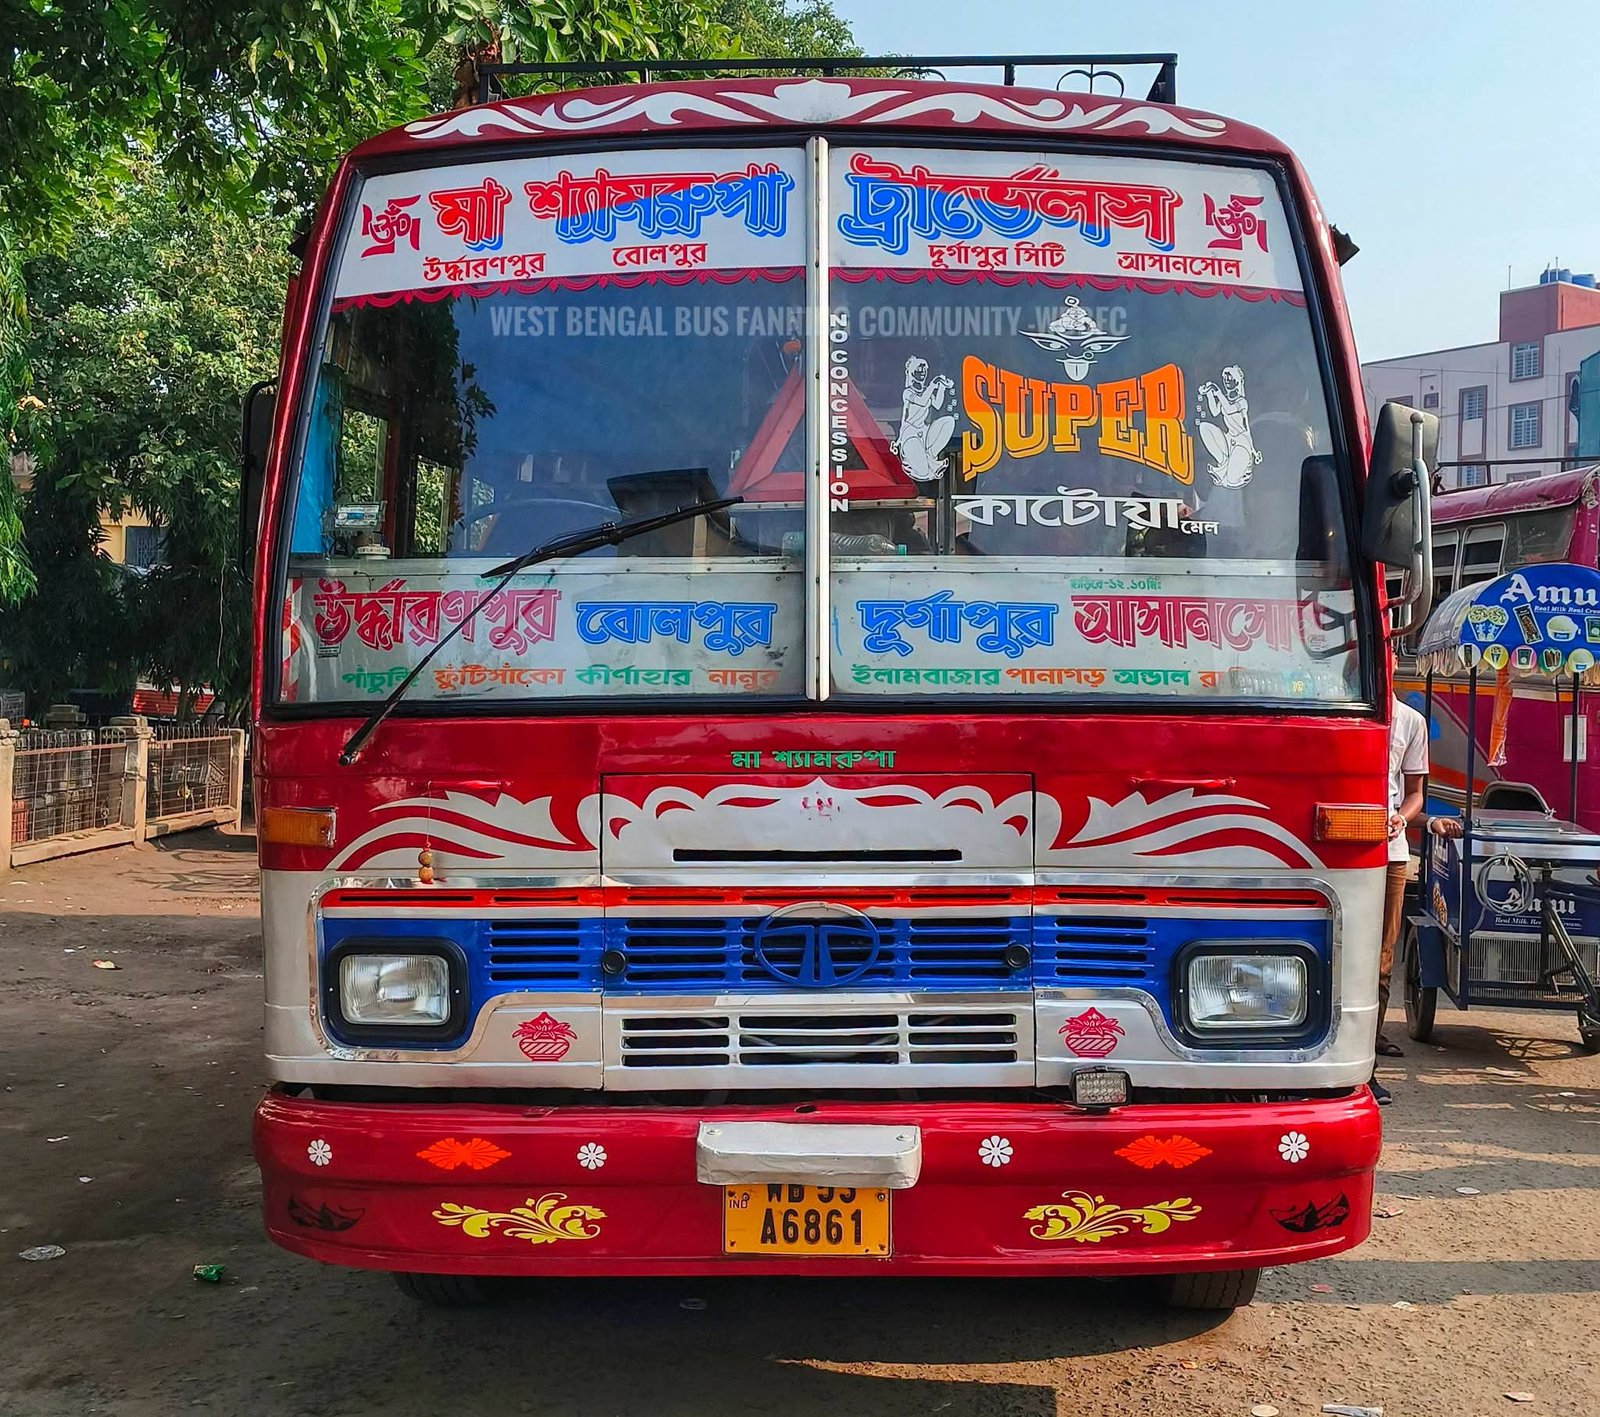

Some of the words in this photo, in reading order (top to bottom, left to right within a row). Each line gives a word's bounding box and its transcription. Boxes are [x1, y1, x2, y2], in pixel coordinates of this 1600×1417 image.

[428, 177, 513, 251] মা
[612, 242, 709, 268] বোলপুর
[1014, 241, 1067, 268] সিটি
[1117, 251, 1242, 278] আসানসোল
[829, 313, 849, 343] NO
[828, 350, 850, 514] CONCESSION
[961, 355, 1195, 486] SUPER
[950, 485, 1184, 531] কাটোয়া
[1180, 520, 1220, 535] মেল
[576, 600, 778, 656] বোলপুর
[850, 663, 1002, 686] ইলামবাজার
[1005, 668, 1107, 688] পানাগড়
[730, 750, 763, 769] মা
[760, 1208, 862, 1246] A6861
